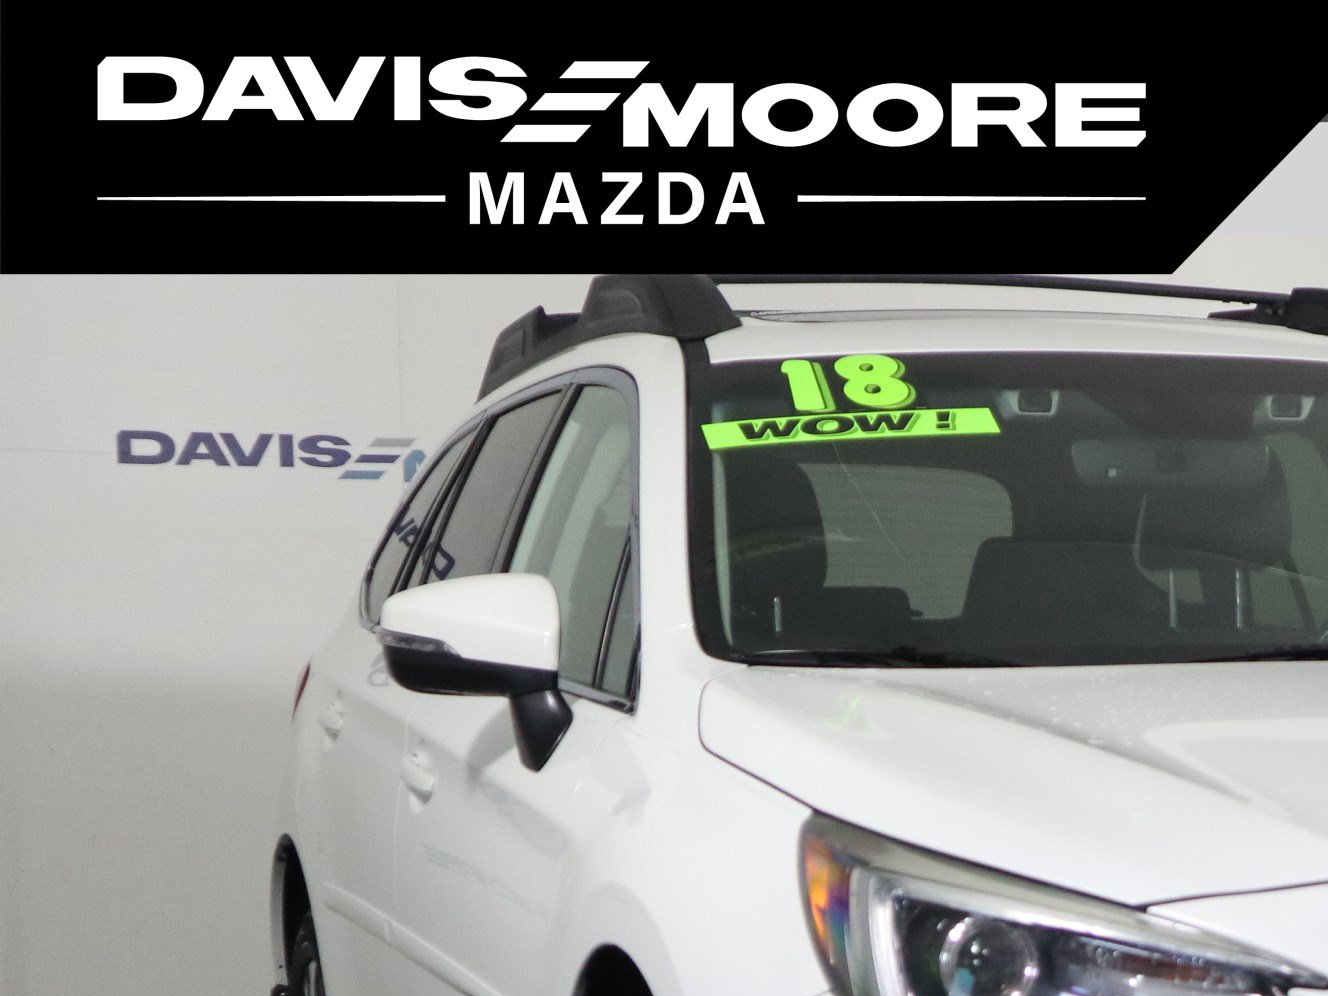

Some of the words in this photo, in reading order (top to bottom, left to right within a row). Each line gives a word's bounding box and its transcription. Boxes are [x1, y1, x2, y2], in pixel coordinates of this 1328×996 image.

[780, 354, 917, 413] 18
[737, 410, 920, 441] WOW
[116, 430, 351, 468] DAVIS
